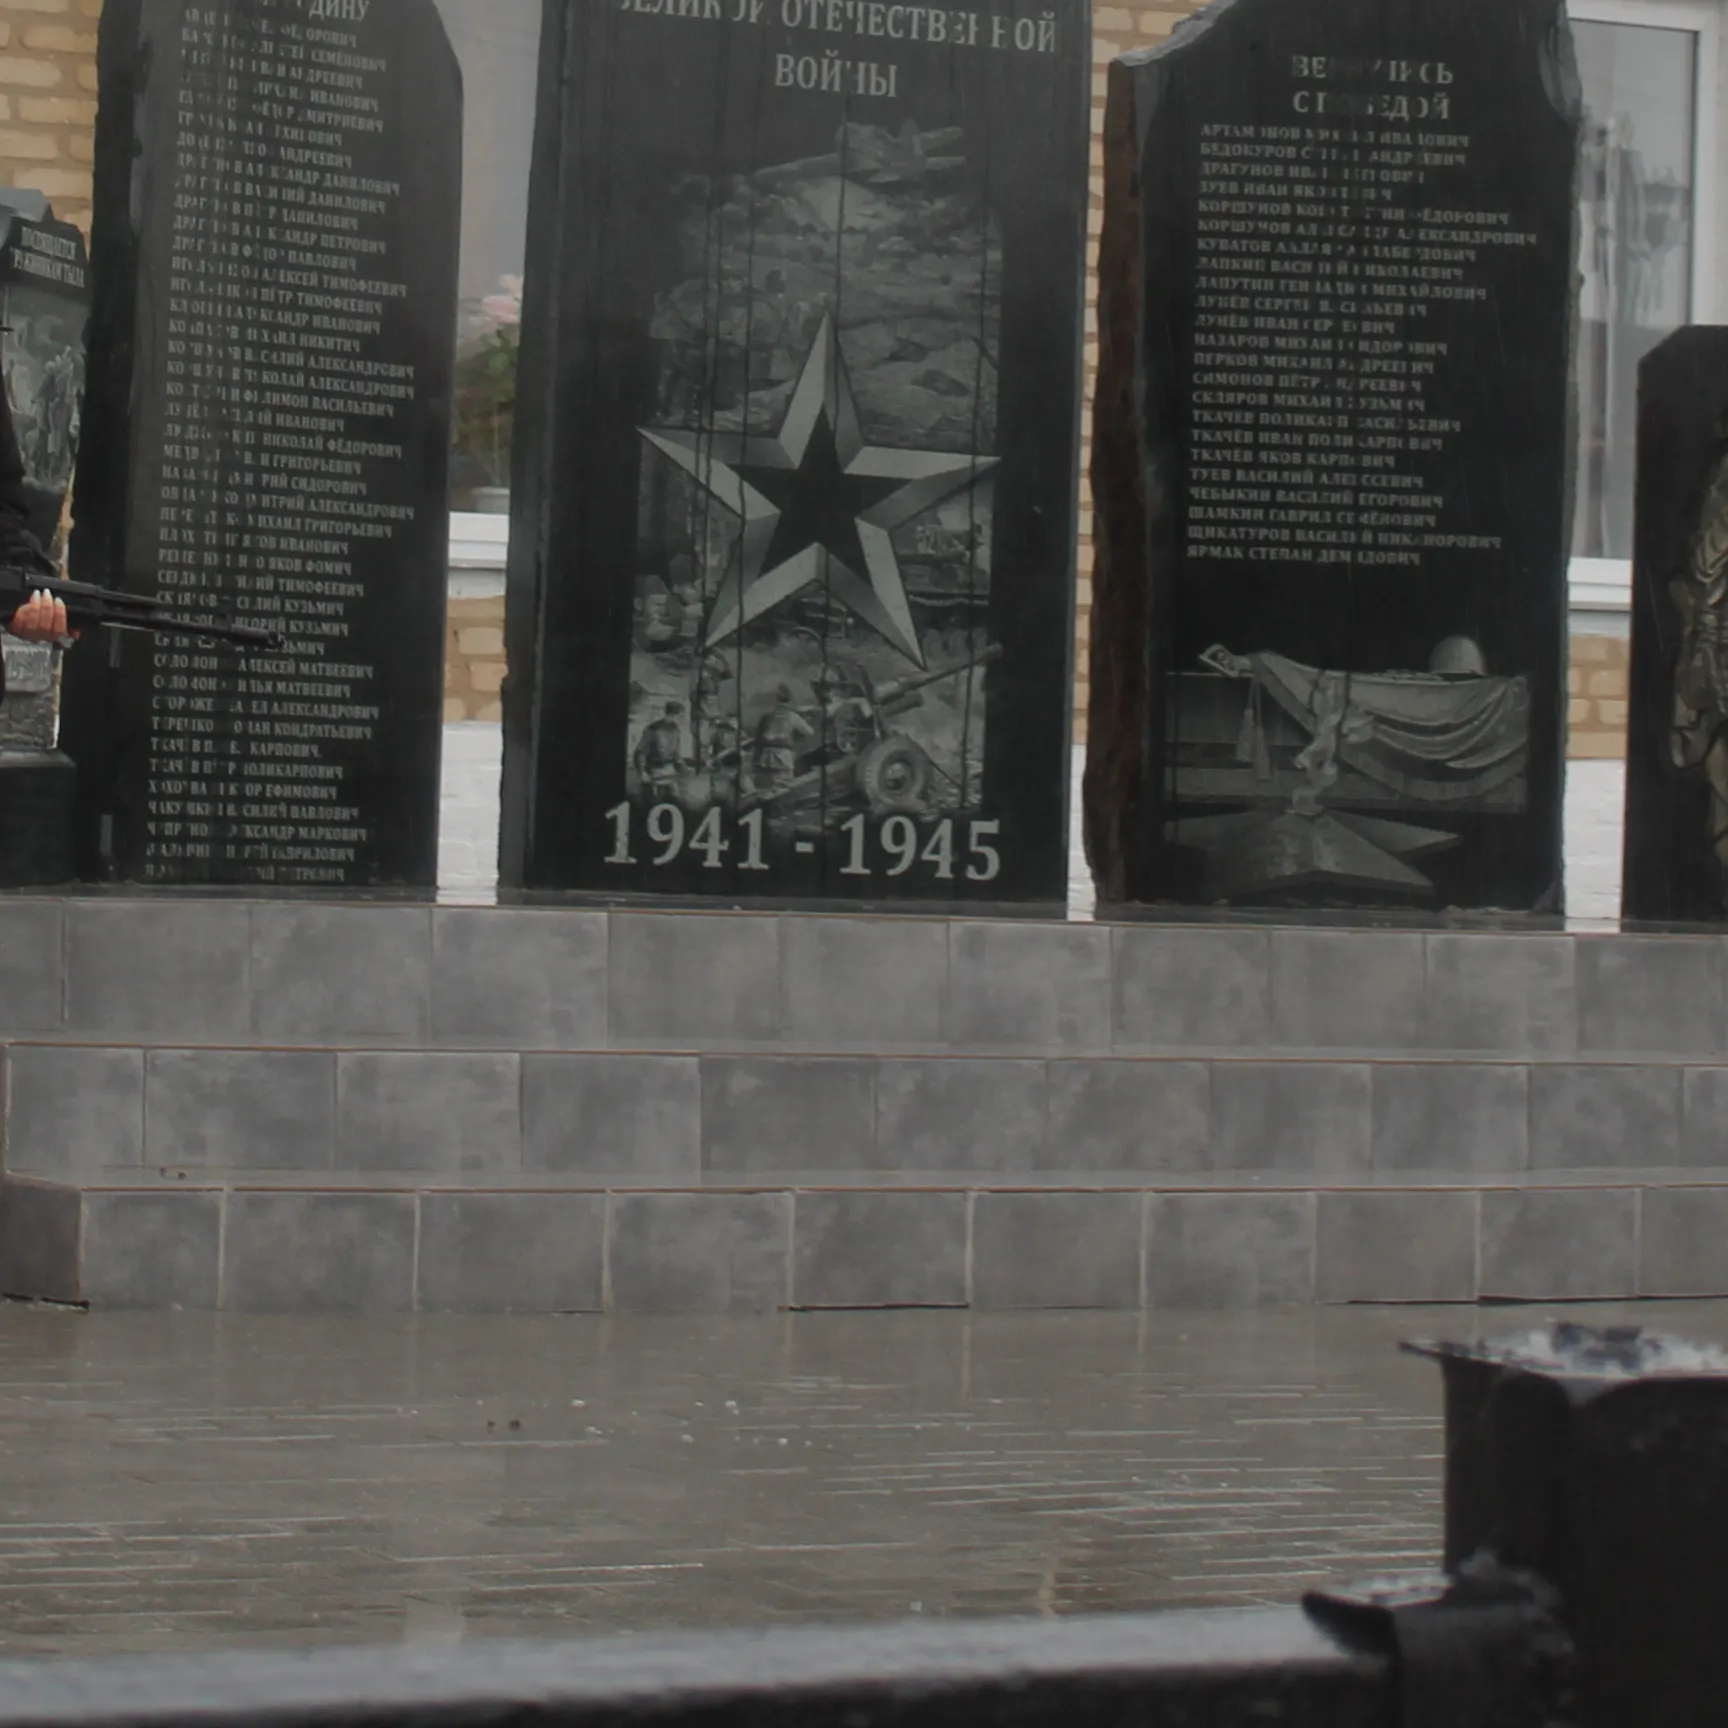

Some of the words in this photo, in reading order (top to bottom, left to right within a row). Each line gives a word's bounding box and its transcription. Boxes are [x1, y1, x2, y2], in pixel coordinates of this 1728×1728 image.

[311, 45, 386, 73] СЕМЁНОВИЧ
[1290, 54, 1454, 85] ВЕЛИСЬ
[774, 44, 898, 99] ВОЙНЫ
[309, 88, 379, 112] ИВАНОВИЧ
[1291, 89, 1310, 113] С
[1315, 86, 1450, 122] ПЕДОЙ
[297, 107, 383, 133] МИТРИЕВИЧ
[1199, 141, 1297, 160] БЕДОКУРОВ
[1368, 149, 1467, 168] АНДРЕВИЧ
[1199, 160, 1284, 178] ДРАГУНОВ
[322, 172, 400, 197] ДАНИЛОВИЧ
[1199, 179, 1239, 194] ЗУЕВ
[1243, 181, 1288, 196] ИВАН
[307, 190, 386, 215] ДАНИЛОВИЧ
[1197, 198, 1291, 216] КОРШУНОВ
[319, 233, 386, 255] ПЕТРОВИЧ
[1196, 237, 1271, 253] КУВАТОВ
[288, 249, 356, 271] ПАВЛОВИЧ
[321, 274, 407, 298] ТИМОФЕЕВИЧ
[1195, 275, 1274, 292] ЛАПУТИН
[295, 291, 382, 315] ТИМОФЕЕВИЧ
[1194, 292, 1249, 310] ЛУНЁВ
[234, 304, 309, 328] АКСАНДР
[311, 313, 380, 335] ИВАНОВИЧ
[1194, 312, 1249, 329] ЛУНЁВ
[1253, 316, 1298, 331] ИВАН
[1302, 318, 1395, 335] СЕРЕВИЧ
[299, 332, 360, 353] НИКИТИЧ
[1194, 333, 1269, 349] НАЗАРОВ
[1347, 339, 1448, 357] ИДОРВИЧ
[243, 345, 304, 367] ВСЛИЙ
[1193, 352, 1259, 368] ПЕРКОВ
[1263, 355, 1337, 371] МИХАИЛ
[1336, 358, 1434, 376] АДРЕЕИЧ
[247, 366, 304, 387] КОЛАЙ
[1191, 371, 1274, 387] СИМОНОВ
[1280, 373, 1322, 389] ПЁТР
[311, 395, 394, 417] ВАСИЛЬЕВИЧ
[1191, 390, 1268, 406] СКЛЯРОВ
[1347, 396, 1425, 412] УЗЬМЧ
[274, 412, 345, 432] ИВАНОВИЧ
[1357, 416, 1461, 433] АСИЬЕВИЧ
[262, 429, 323, 451] НИКОЛАЙ
[326, 436, 402, 459] ФЁДОРОВИЧ
[1191, 427, 1253, 444] ТКАЧЁВ
[1258, 431, 1303, 446] ИВАН
[1308, 433, 1443, 451] ПОЛИАРПВИЧ
[272, 453, 361, 475] ГРИГОРЬЕВИЧ
[1190, 446, 1253, 463] ТКАЧЁВ
[1257, 451, 1302, 465] ЯКОВ
[290, 475, 367, 497] СИДОРОВИЧ
[1189, 467, 1231, 482] ТУЕВ
[1235, 467, 1313, 485] ВАСИЛИЙ
[1188, 486, 1271, 502] ЧЕБЫКИН
[1275, 487, 1354, 505] ВАСИЛИЙ
[1357, 492, 1443, 508] ЕГОРОВИЧ
[1187, 506, 1265, 521] ШАМКИН
[1268, 508, 1332, 523] ГАВРИЛ
[303, 518, 392, 538] ГРИГОРЬЕВИЧ
[1187, 525, 1290, 542] ЩИКАТУРОВ
[1377, 531, 1501, 548] НИКНОРОВИЧ
[279, 536, 349, 555] ИВАНОВИЧ
[1186, 544, 1244, 559] ЯРМАК
[1248, 546, 1313, 561] СТЕПАН
[268, 556, 302, 572] ЯКОВ
[304, 559, 352, 575] ФОМИЧ
[278, 577, 364, 597] ТИМОФЕЕВИЧ
[283, 598, 344, 616] КУЗЬМИЧ
[288, 619, 349, 636] КУЗЬМИЧ
[298, 661, 373, 678] МАТВЕЕВИЧ
[275, 680, 351, 697] МАТВЕЕВИЧ
[273, 721, 372, 740] КОНДРАТЬЕВИЧ
[265, 783, 338, 799] ЕФИМОВИЧ
[226, 800, 287, 817] ВСИЛИЙ
[290, 804, 359, 820] ПАВЛОВИЧ
[297, 825, 367, 840] МАРКОВИЧ
[604, 801, 770, 870] 1941
[794, 841, 815, 854] -
[839, 813, 1002, 881] 1945
